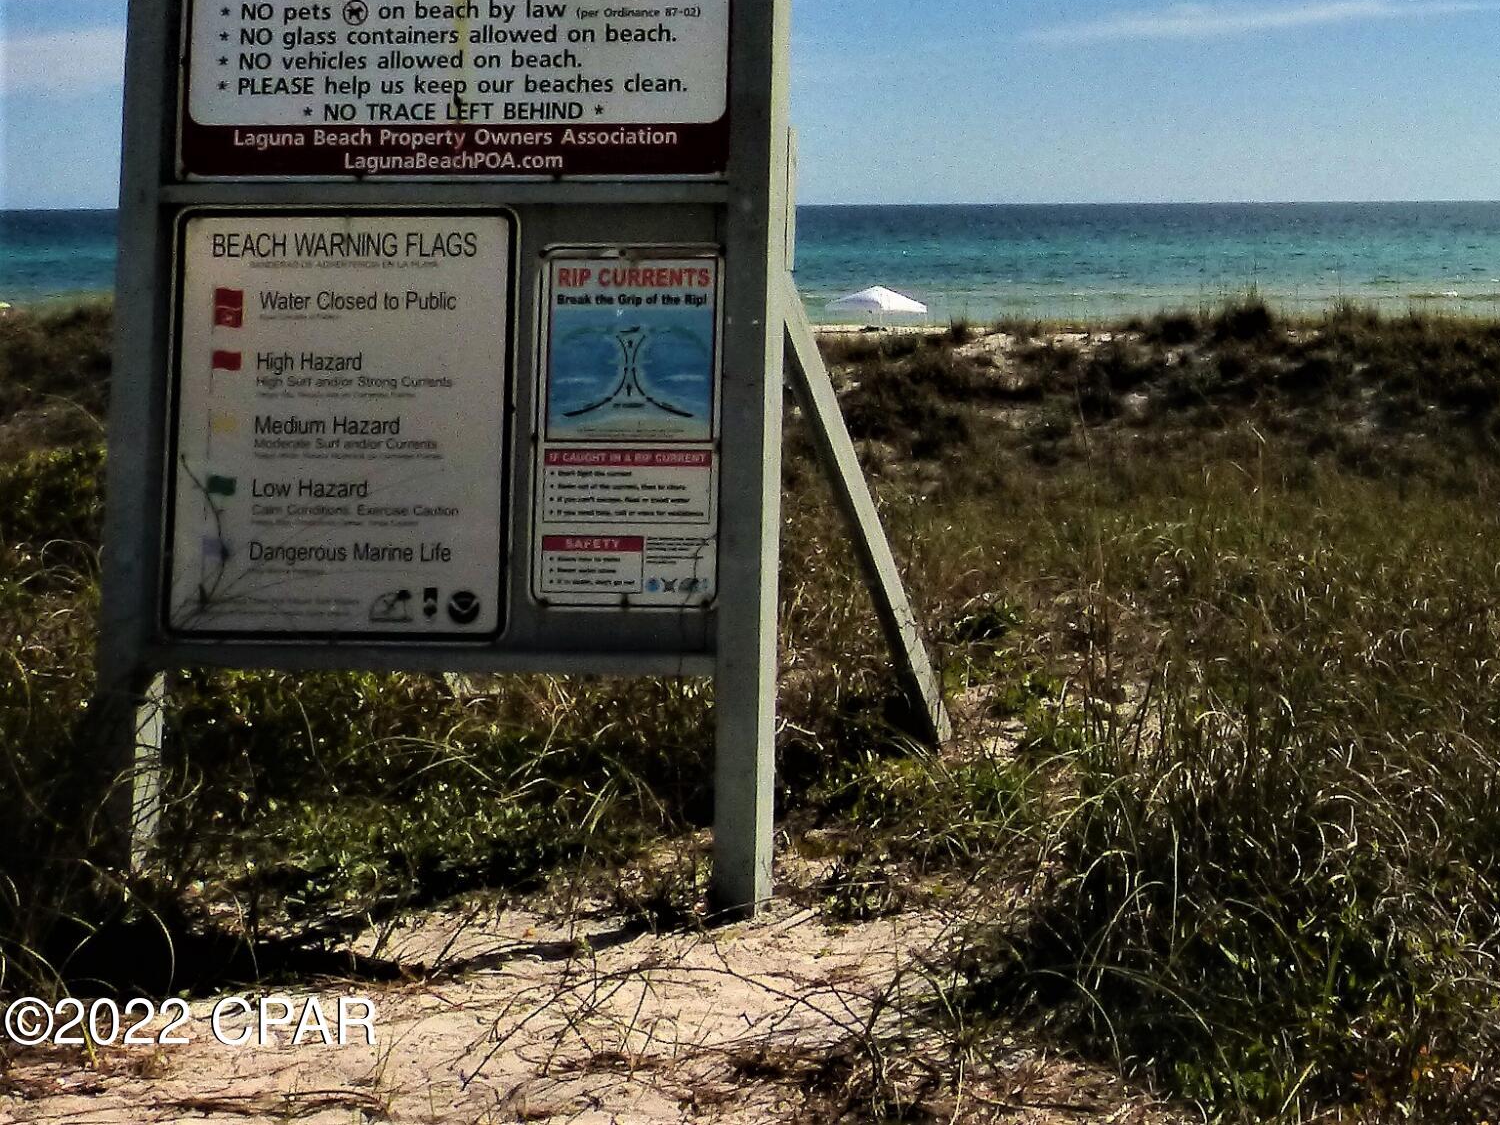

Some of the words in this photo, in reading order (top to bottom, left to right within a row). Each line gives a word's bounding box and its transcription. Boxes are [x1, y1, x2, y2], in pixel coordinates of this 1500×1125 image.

[241, 4, 274, 20] NO
[284, 4, 331, 25] pets
[379, 4, 404, 19] on
[415, 0, 479, 19] beach
[489, 0, 515, 23] by
[526, 0, 567, 18] law
[240, 28, 273, 45] NO
[283, 27, 336, 49] glass
[347, 26, 459, 44] containers
[469, 24, 557, 43] allowed
[567, 28, 595, 42] on
[605, 24, 677, 42] beach.
[239, 53, 271, 70] NO
[283, 51, 367, 70] vehicles
[377, 50, 463, 69] allowed
[474, 54, 500, 68] on
[511, 49, 582, 68] beach.
[238, 77, 315, 95] PLEASE
[325, 76, 371, 98] help
[381, 79, 404, 94] us
[415, 75, 467, 99] keep
[477, 79, 514, 93] our
[525, 74, 613, 93] beaches
[624, 74, 687, 92] clean.
[324, 104, 357, 121] NO
[366, 103, 435, 121] TRACE
[447, 103, 494, 120] LEFT
[504, 102, 583, 119] BEHIND
[234, 130, 305, 151] Laguna
[314, 128, 371, 146] Beach
[380, 130, 465, 149] Property
[475, 128, 552, 145] Owners
[561, 127, 677, 145] Association
[344, 152, 563, 173] LagunaBeachPOA.com
[212, 233, 287, 258] BEACH
[295, 232, 397, 258] WARNING
[406, 232, 477, 257] FLAGS
[558, 268, 591, 287] RIP
[598, 268, 710, 287] CURRENTS
[260, 291, 311, 310] Water
[317, 291, 377, 310] Closed
[384, 292, 399, 310] to
[405, 291, 457, 310] Public
[557, 294, 591, 305] Break
[595, 294, 613, 304] the
[618, 294, 642, 307] Grip
[646, 294, 657, 304] of
[662, 294, 680, 305] the
[685, 294, 707, 307] Rip!
[257, 352, 294, 375] High
[301, 352, 362, 371] Hazard
[358, 377, 397, 390] Strong
[254, 415, 325, 435] Medium
[333, 415, 400, 435] Hazard
[252, 480, 291, 497] Low
[299, 479, 368, 497] Hazard
[250, 542, 346, 565] Dangerous
[354, 543, 412, 563] Marine
[420, 543, 451, 563] Life
[566, 539, 620, 549] SAFETY
